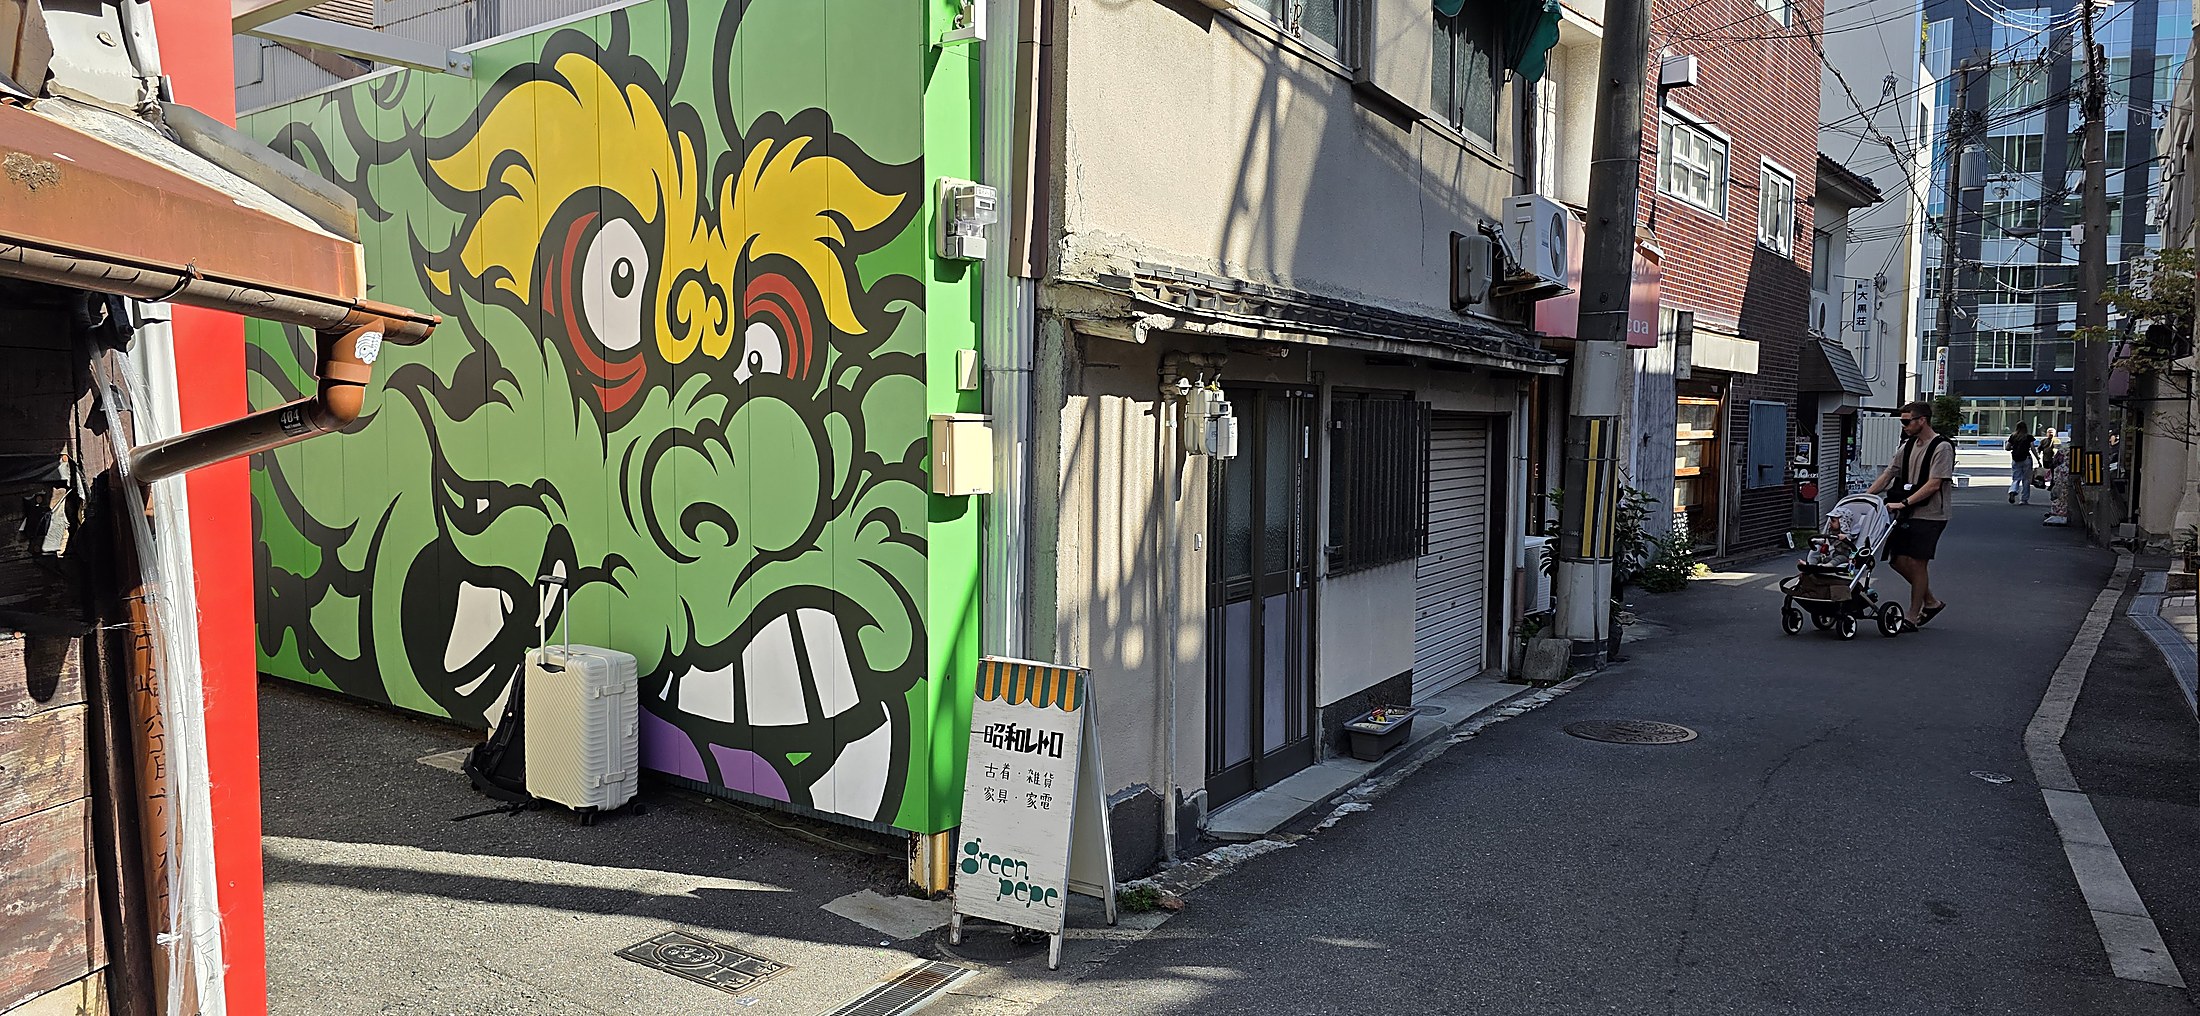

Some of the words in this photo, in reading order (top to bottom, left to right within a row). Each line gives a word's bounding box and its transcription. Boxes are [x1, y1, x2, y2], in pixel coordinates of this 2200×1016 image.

[1856, 291, 1868, 326] 大黒荘
[281, 409, 300, 424] 404
[983, 723, 1064, 759] 昭和レトロ
[961, 837, 1029, 880] green
[996, 877, 1059, 909] pepe
